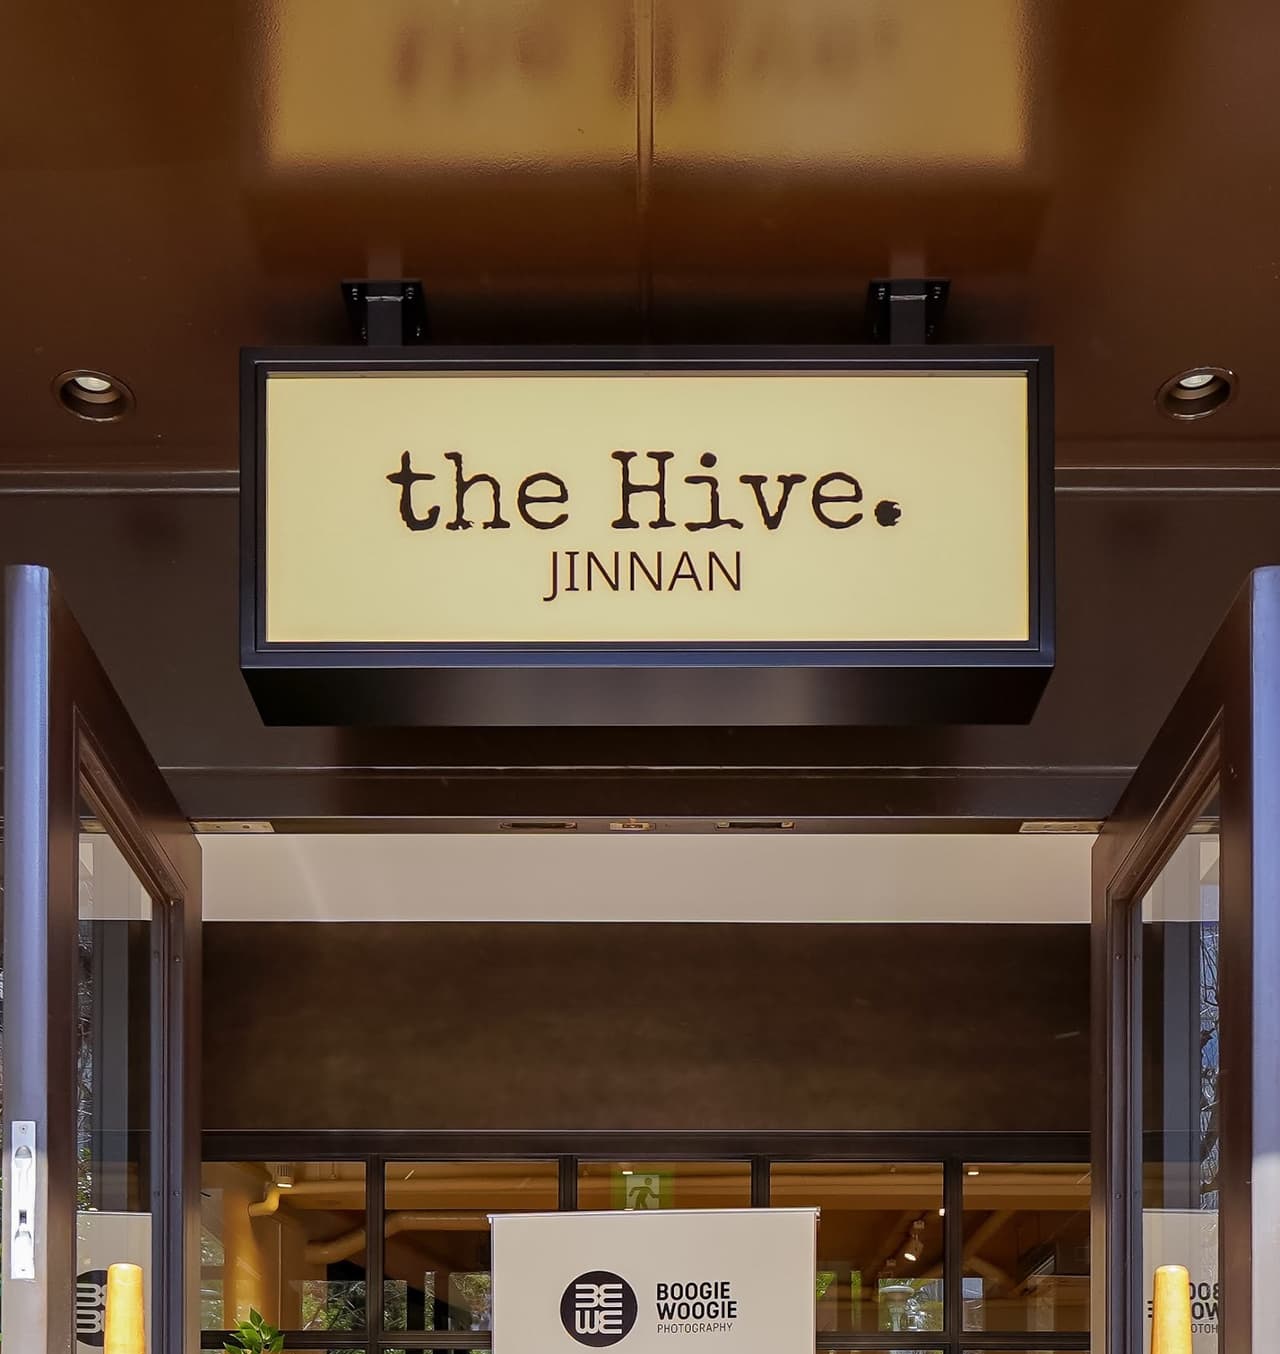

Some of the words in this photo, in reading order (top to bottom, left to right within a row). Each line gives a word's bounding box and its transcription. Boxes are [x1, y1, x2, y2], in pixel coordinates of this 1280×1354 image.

[386, 450, 570, 532] the
[611, 450, 903, 532] Hive.
[543, 549, 743, 602] JINNAN
[656, 1281, 731, 1301] BOOGIE
[656, 1301, 738, 1320] WOOGIE
[657, 1322, 734, 1334] PHOTOGRAPHY
